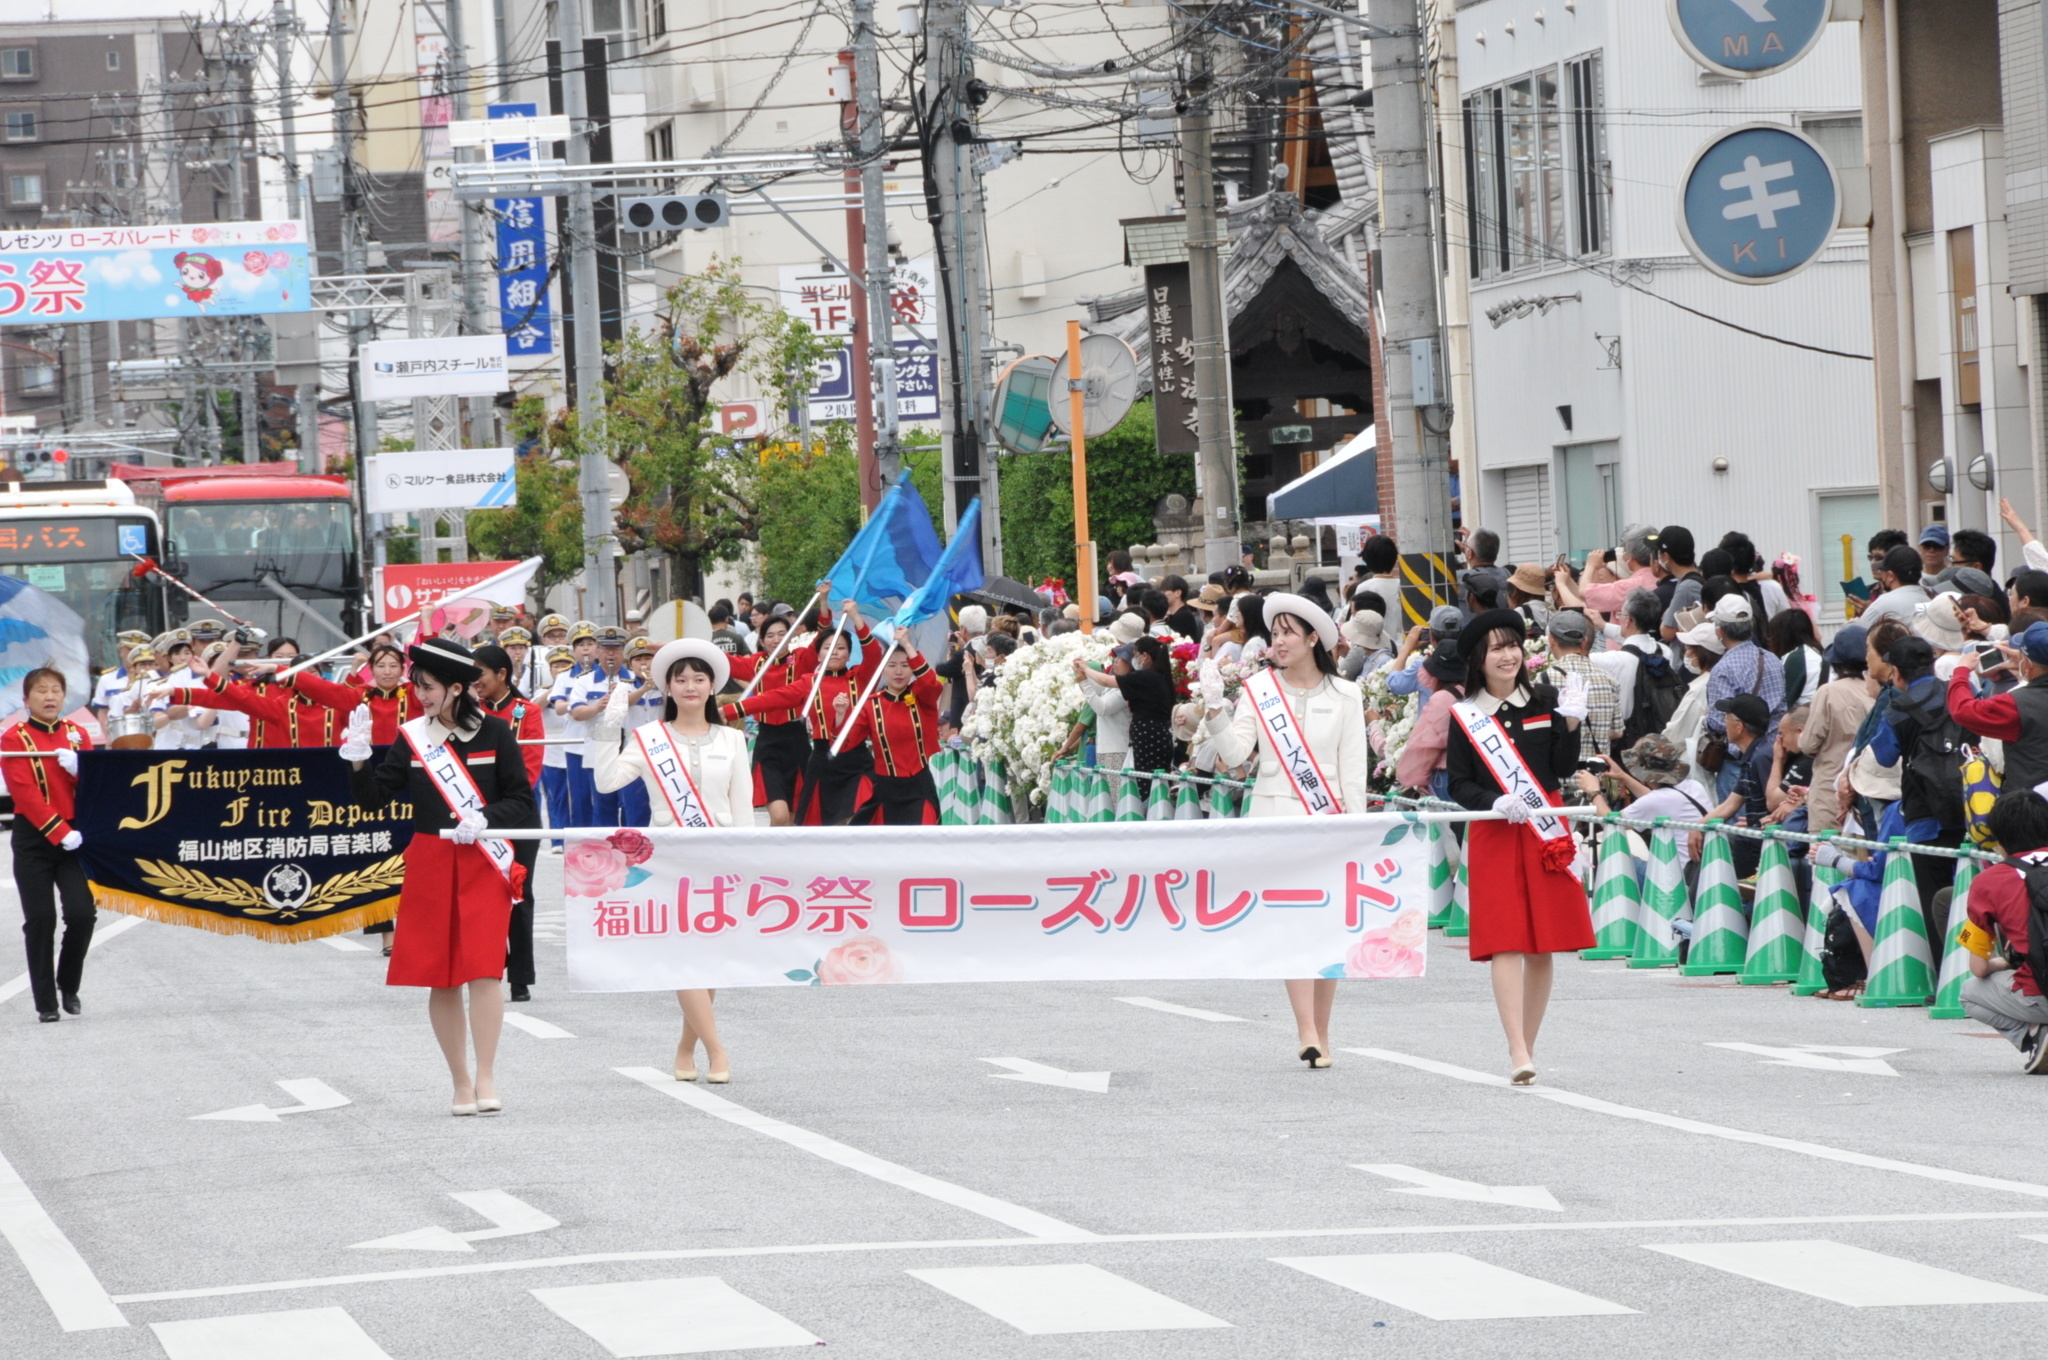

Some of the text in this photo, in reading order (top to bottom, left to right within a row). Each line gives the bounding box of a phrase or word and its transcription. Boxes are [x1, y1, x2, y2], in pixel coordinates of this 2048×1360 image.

[1723, 31, 1785, 57] MA
[1719, 155, 1801, 229] キ
[1732, 236, 1786, 264] KI
[801, 284, 851, 303] 当ビル
[810, 306, 847, 331] 1F
[1153, 286, 1175, 393] 日蓮宗 本性山
[395, 357, 488, 375] 瀬戸内スチール
[721, 404, 757, 435] P
[404, 472, 507, 486] マルケー食品株式会社
[1268, 713, 1330, 812] ローズ福山
[118, 759, 303, 831] Fukuyama
[220, 796, 292, 829] Fire
[178, 831, 393, 862] 福山地区消防局音楽隊
[592, 857, 1402, 939] 福山ばら祭 ローズパレード
